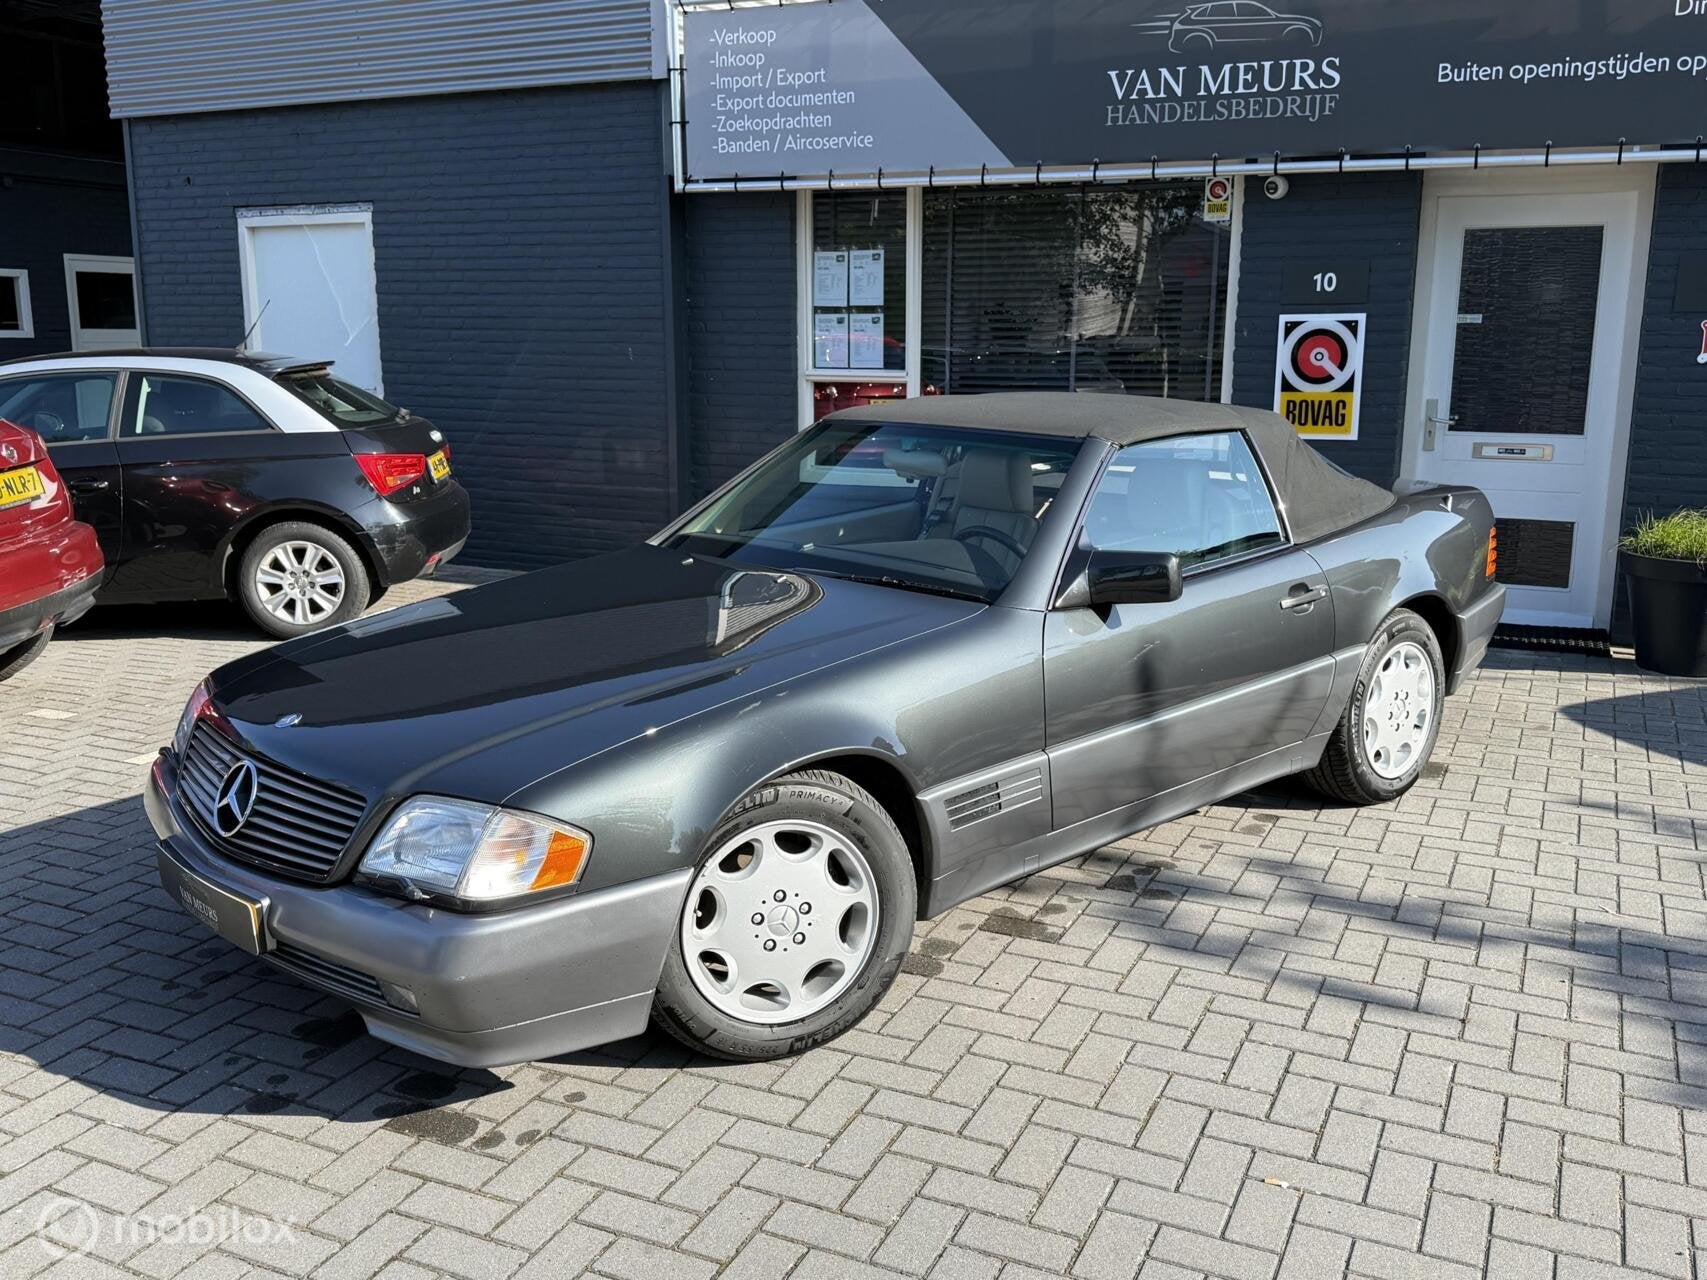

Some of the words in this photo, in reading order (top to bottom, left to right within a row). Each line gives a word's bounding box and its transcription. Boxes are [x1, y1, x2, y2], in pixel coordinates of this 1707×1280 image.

[709, 27, 776, 46] -Verkoop
[710, 50, 765, 69] -Inkoop
[1437, 61, 1503, 83] Buiten
[1509, 52, 1670, 84] openingstijden
[1676, 55, 1707, 76] op
[710, 73, 763, 92] -Import
[765, 68, 773, 88] /
[776, 68, 826, 90] Export
[1107, 66, 1187, 100] VAN
[1197, 57, 1341, 96] MEURS
[711, 93, 764, 114] -Export
[766, 88, 856, 109] documenten
[1104, 94, 1340, 126] HANDELSBEDRIJF
[712, 113, 832, 133] -Zoekopdrachten
[712, 133, 770, 154] -Banden
[773, 134, 781, 153] /
[784, 131, 874, 152] Aircoservice
[1207, 203, 1227, 213] BOVAG
[1313, 272, 1337, 292] 10
[1285, 399, 1347, 427] BOVAG
[789, 790, 838, 805] PRIMACY
